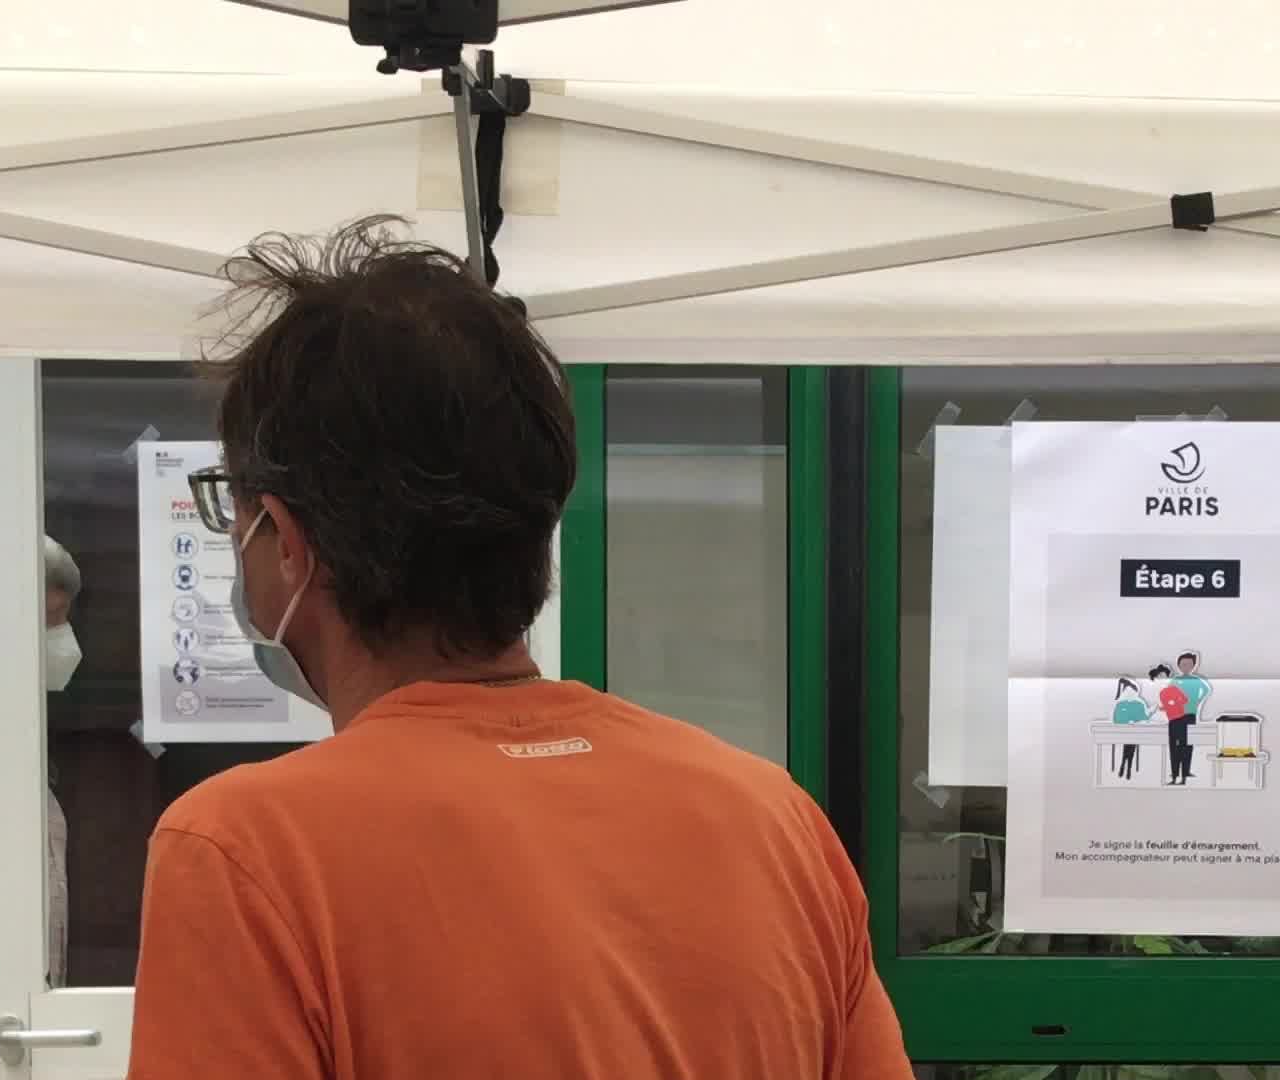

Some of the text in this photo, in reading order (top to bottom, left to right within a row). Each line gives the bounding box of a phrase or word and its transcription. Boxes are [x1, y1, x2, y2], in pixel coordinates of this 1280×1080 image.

[1158, 486, 1209, 495] VILLE DE
[171, 501, 195, 510] POU
[1145, 496, 1219, 516] PARIS
[1135, 564, 1225, 593] Étape 6
[1088, 839, 1101, 849] Je
[1103, 840, 1132, 851] signe
[1146, 839, 1179, 849] feuille
[1055, 852, 1079, 861] Mon
[1081, 853, 1170, 864] accompagnateur
[1173, 854, 1198, 865] peut
[1245, 855, 1261, 863] ma
